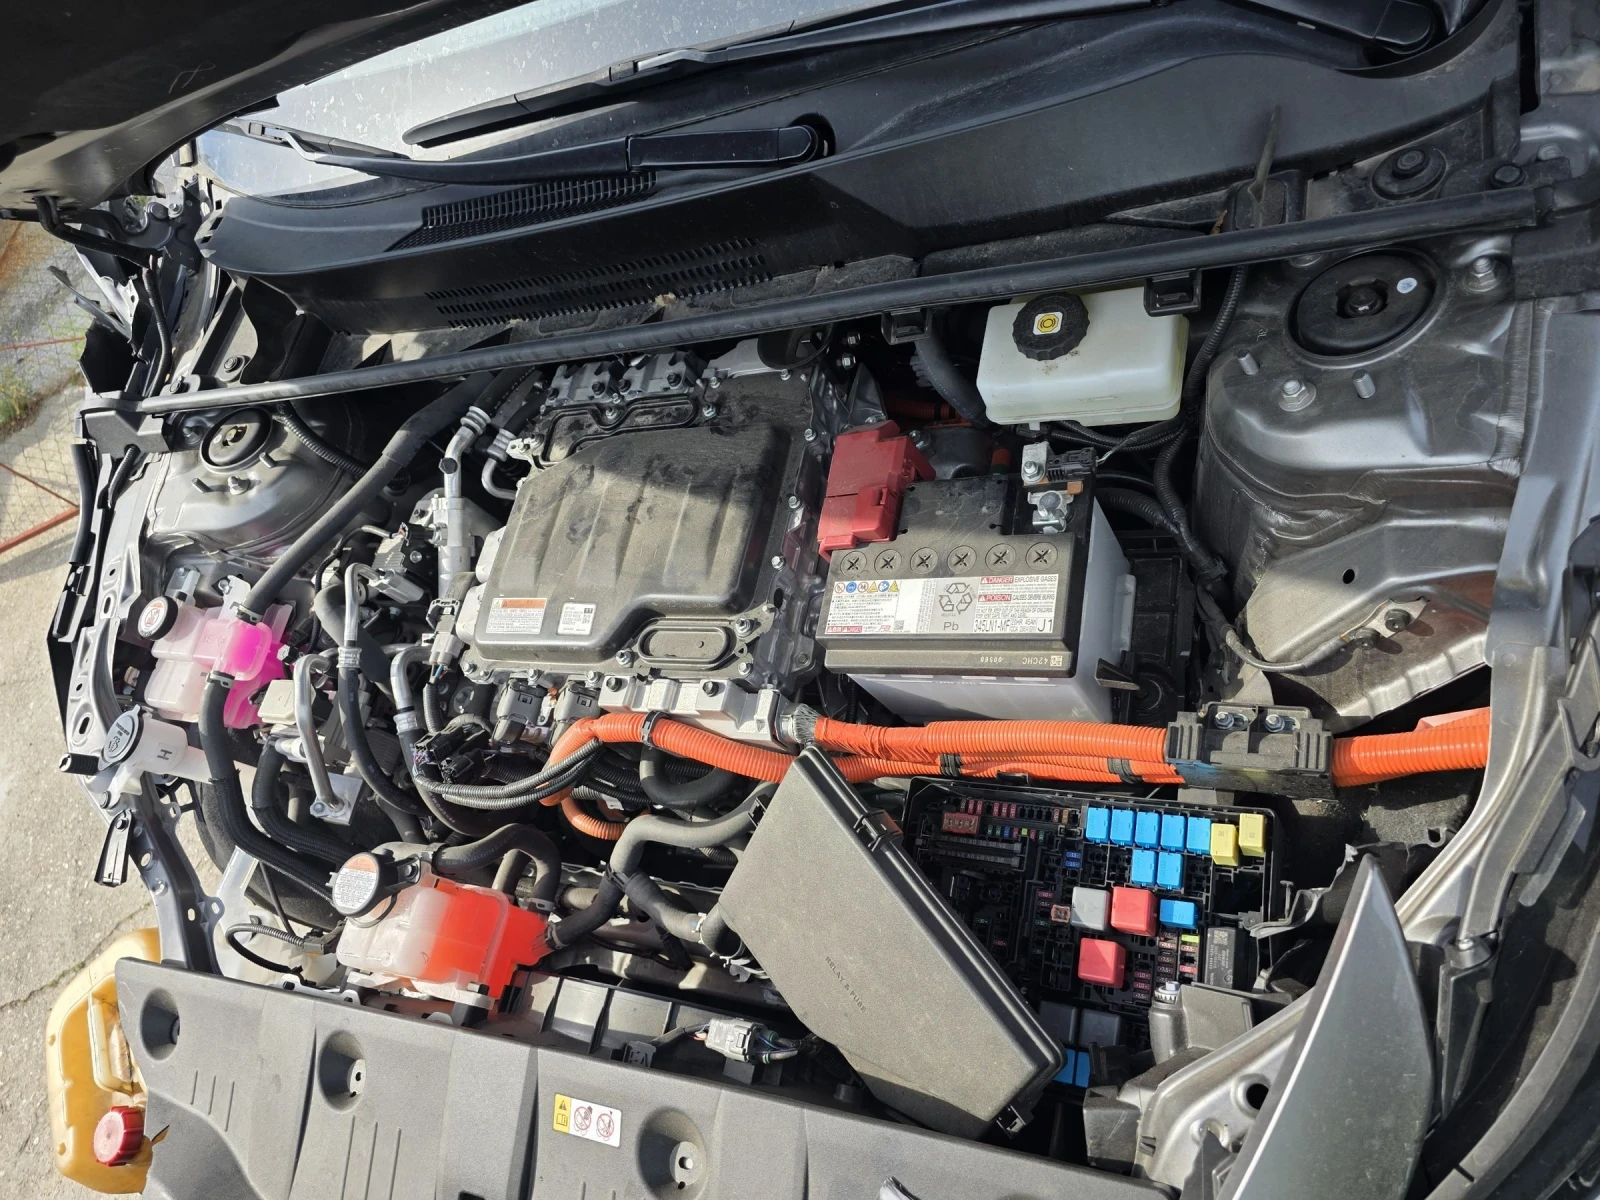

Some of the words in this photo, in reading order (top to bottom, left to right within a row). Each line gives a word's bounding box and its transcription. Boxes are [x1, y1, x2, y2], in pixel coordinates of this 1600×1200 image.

[943, 622, 959, 631] Pb
[974, 619, 1010, 632] 345LN1-MF
[1038, 619, 1053, 632] J1
[825, 956, 846, 982] RELAY
[850, 990, 867, 1013] FUSE
